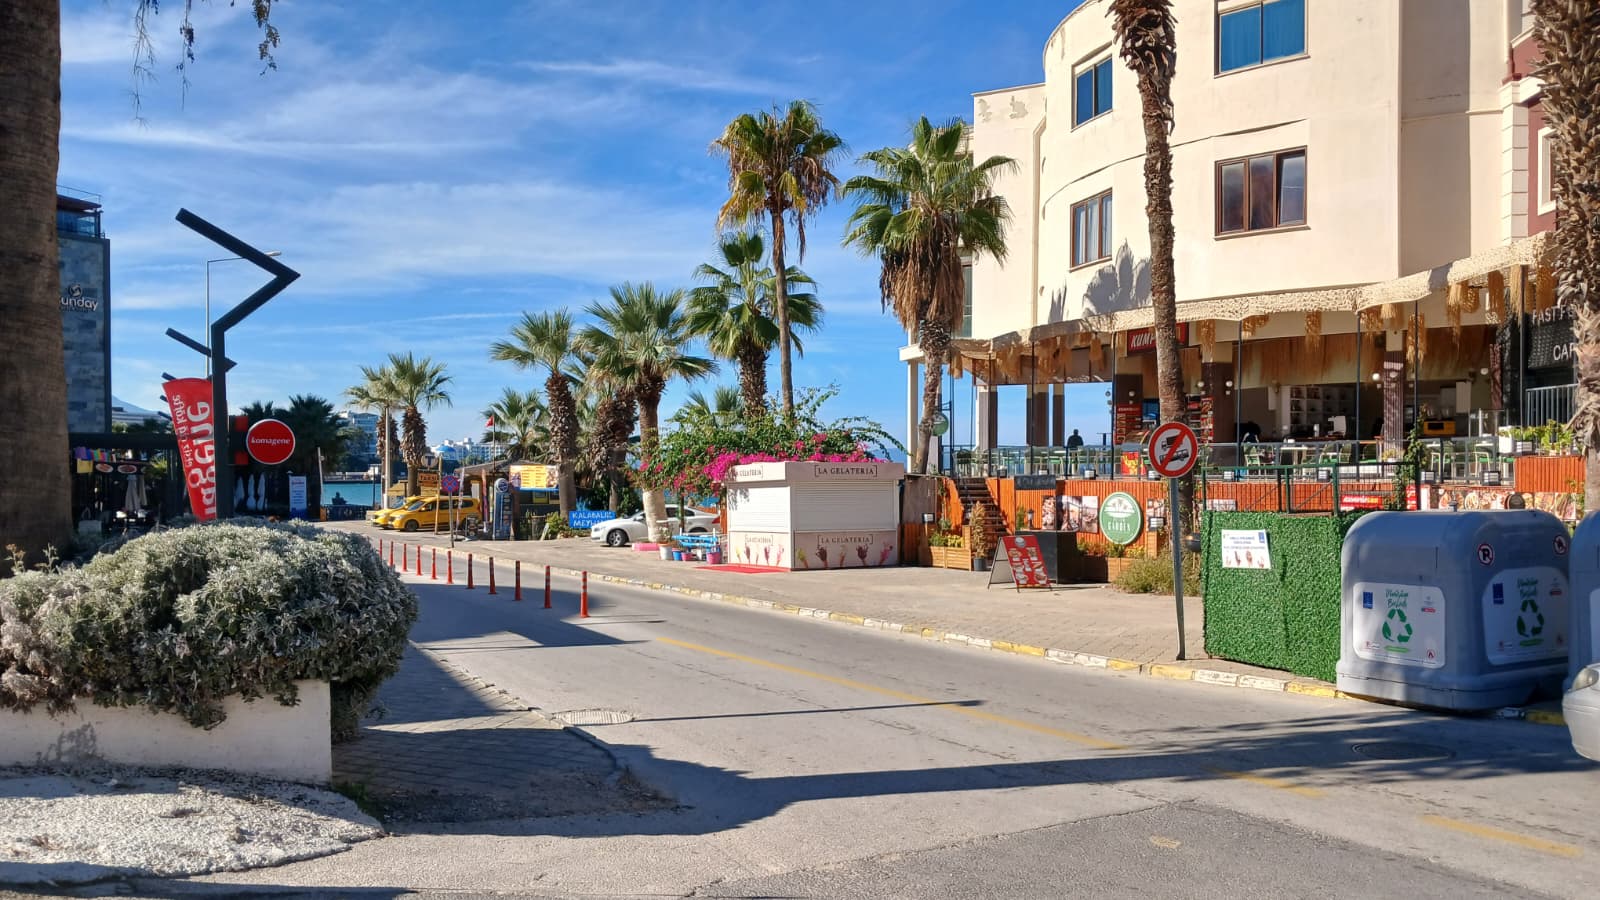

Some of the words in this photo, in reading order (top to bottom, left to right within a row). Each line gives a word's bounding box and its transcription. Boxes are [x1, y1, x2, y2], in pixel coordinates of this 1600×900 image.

[60, 296, 98, 311] unday
[251, 436, 290, 446] komagene
[818, 467, 828, 475] LA
[830, 467, 874, 475] GELATERIA
